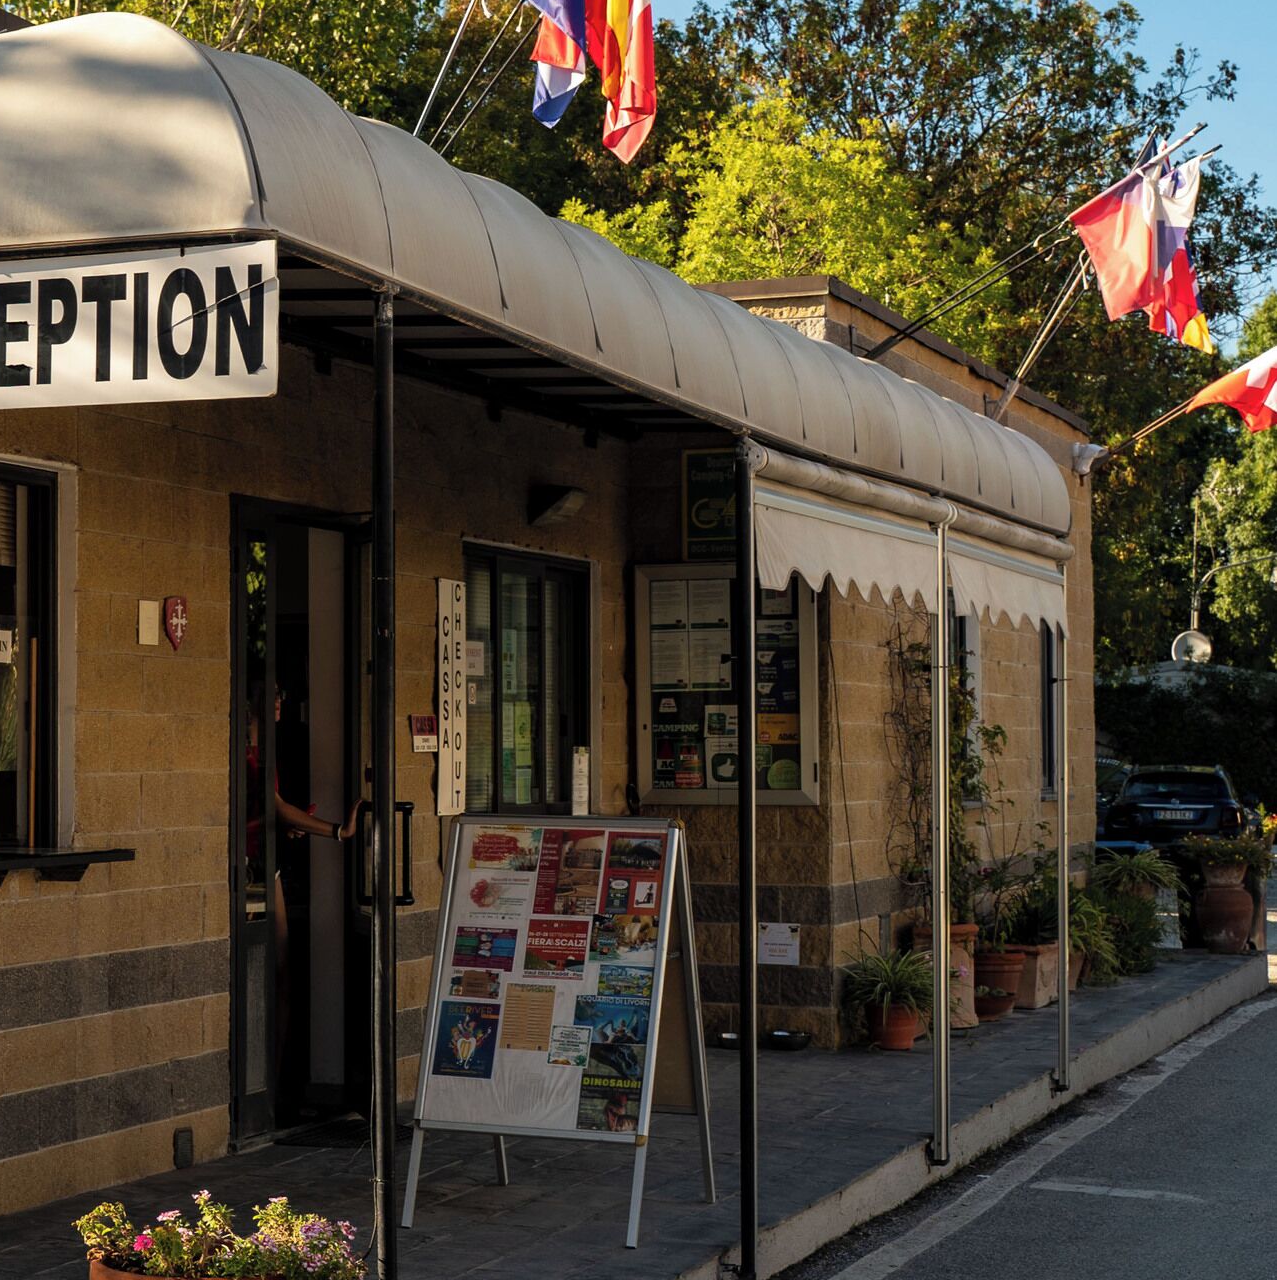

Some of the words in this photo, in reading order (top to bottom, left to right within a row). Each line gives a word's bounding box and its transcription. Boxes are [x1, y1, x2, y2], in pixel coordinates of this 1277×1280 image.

[454, 583, 462, 719] CHECK
[442, 615, 450, 750] CASSA
[653, 723, 700, 733] CAMPING
[454, 731, 462, 809] OUT
[527, 937, 553, 946] FIERA
[554, 938, 587, 947] SCALZI
[577, 995, 614, 1005] ACQUARIO
[624, 998, 651, 1007] LIVORN
[581, 1076, 641, 1089] DINOSAURI
